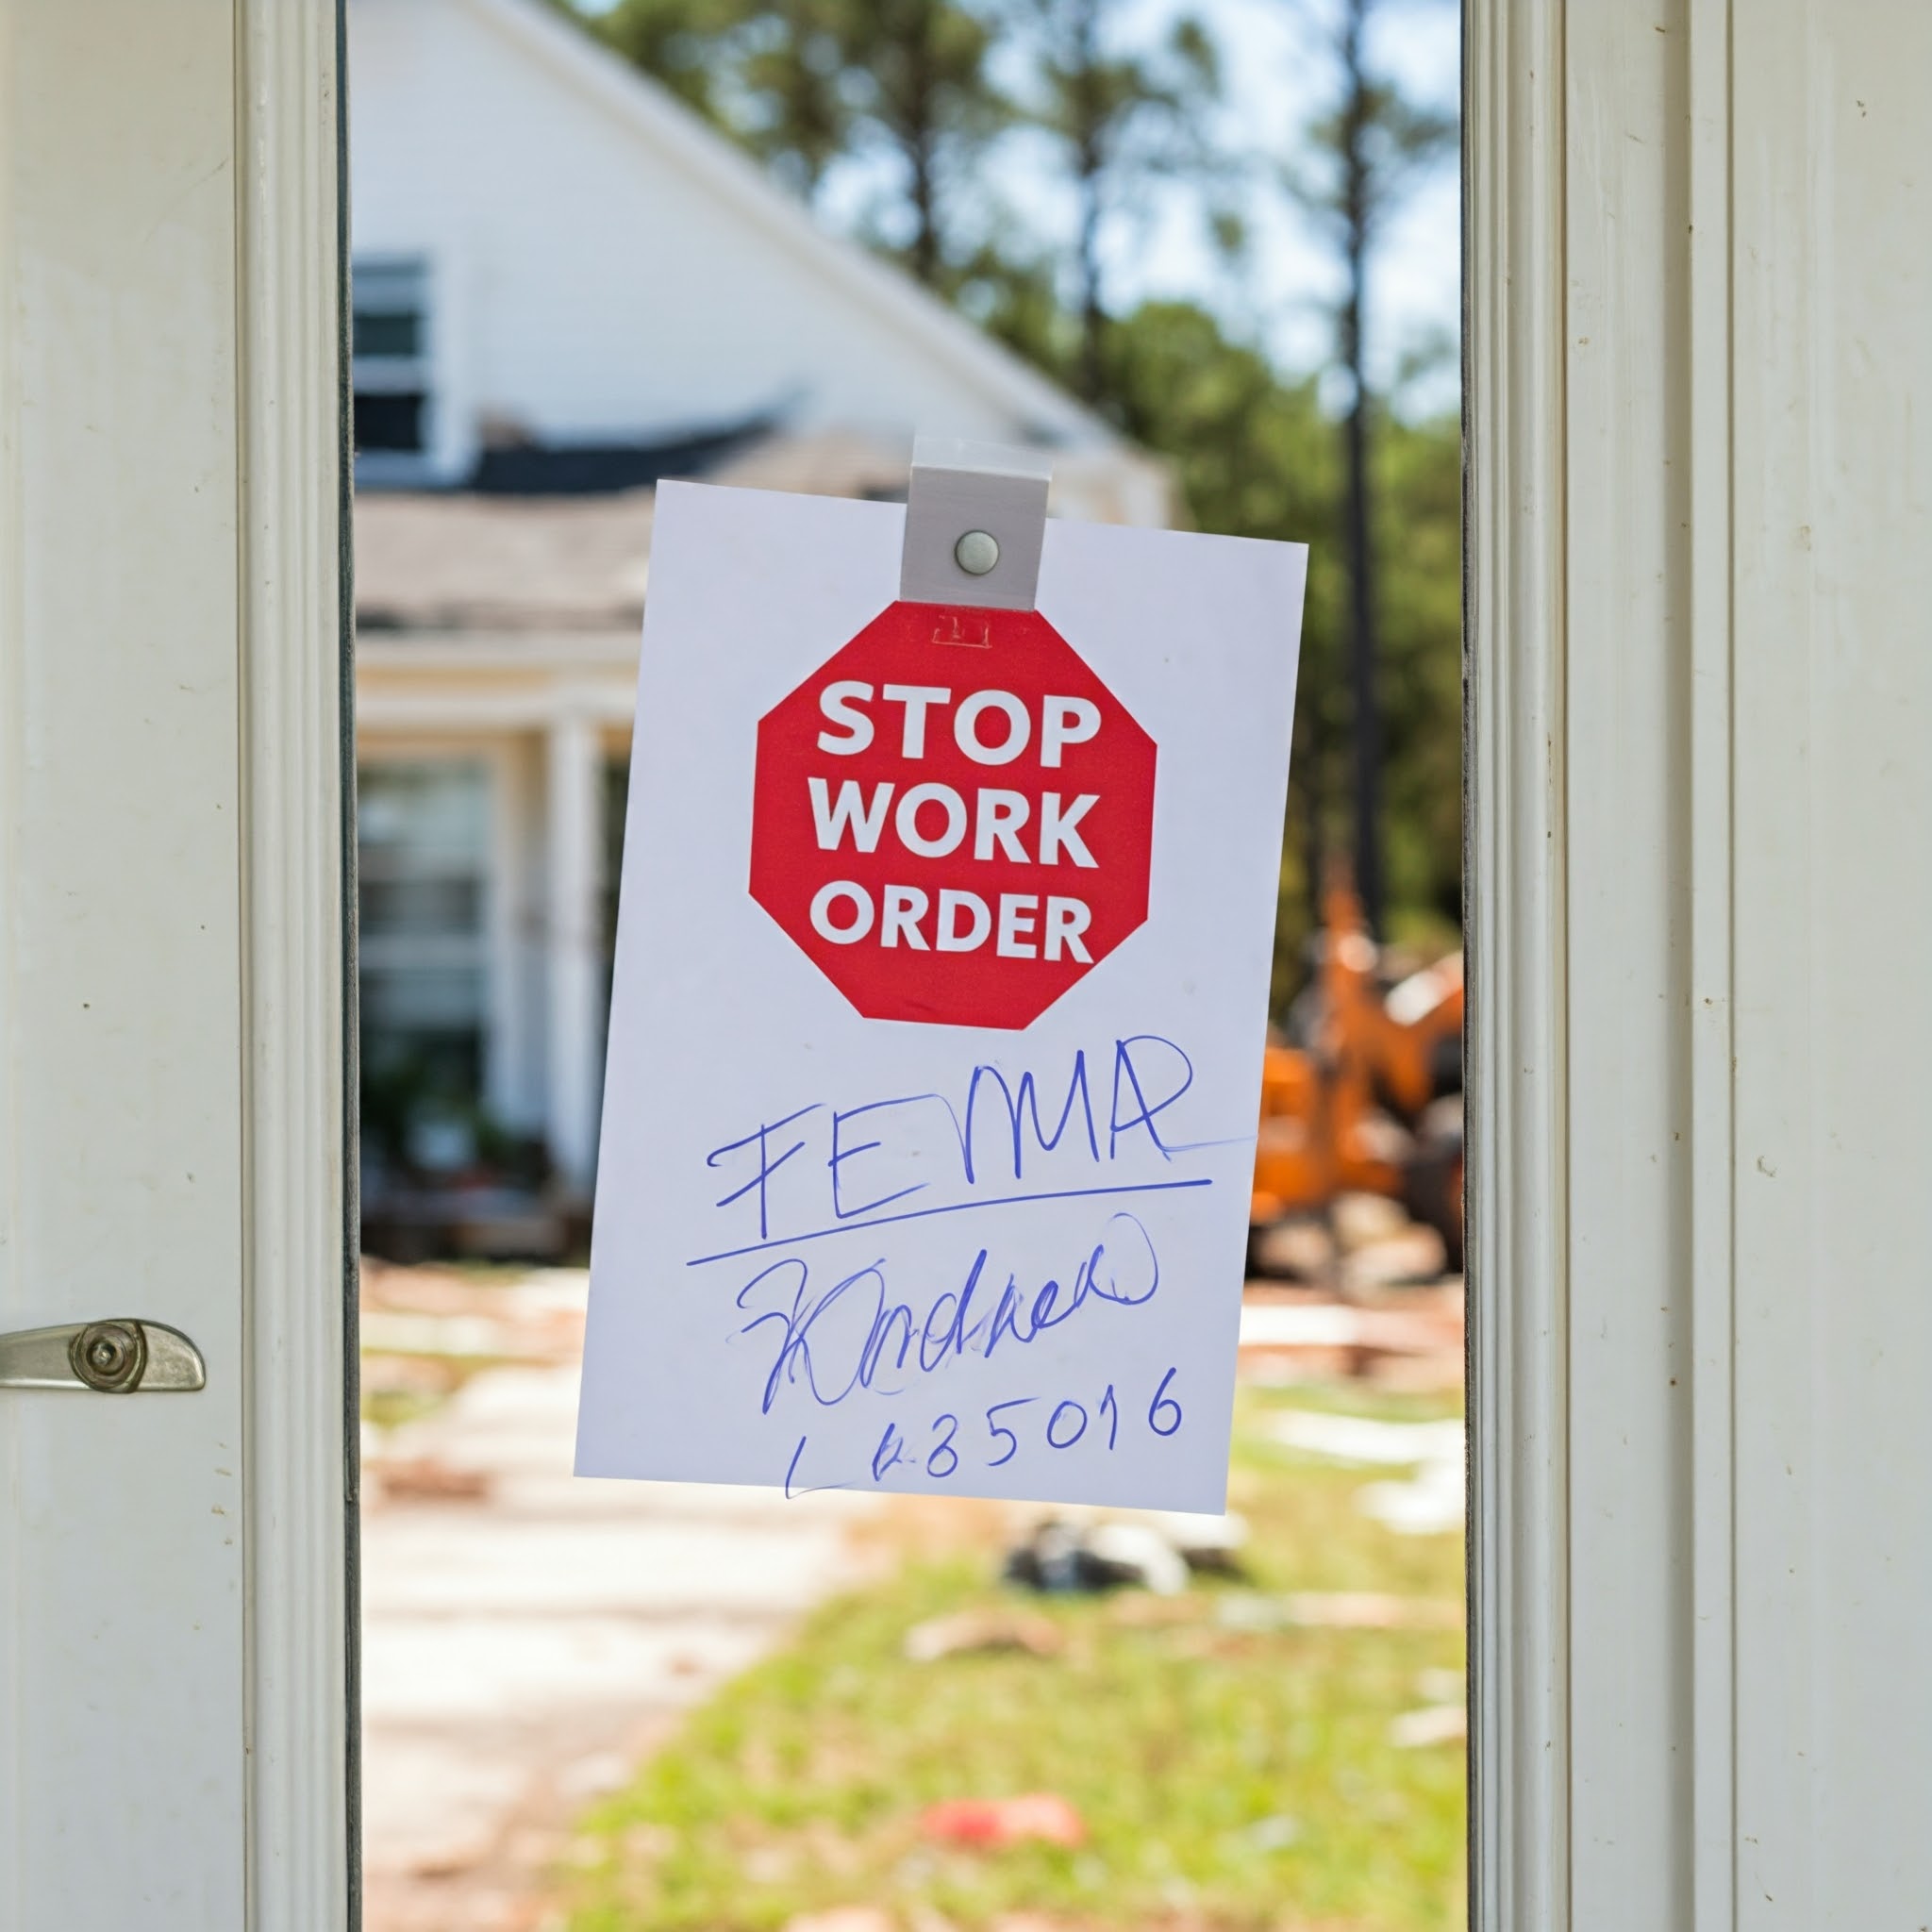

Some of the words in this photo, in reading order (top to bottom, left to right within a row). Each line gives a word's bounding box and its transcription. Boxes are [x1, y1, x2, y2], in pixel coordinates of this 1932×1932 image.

[817, 679, 1102, 768] STOP
[808, 777, 1100, 869] WORK
[810, 879, 1094, 964] ORDER
